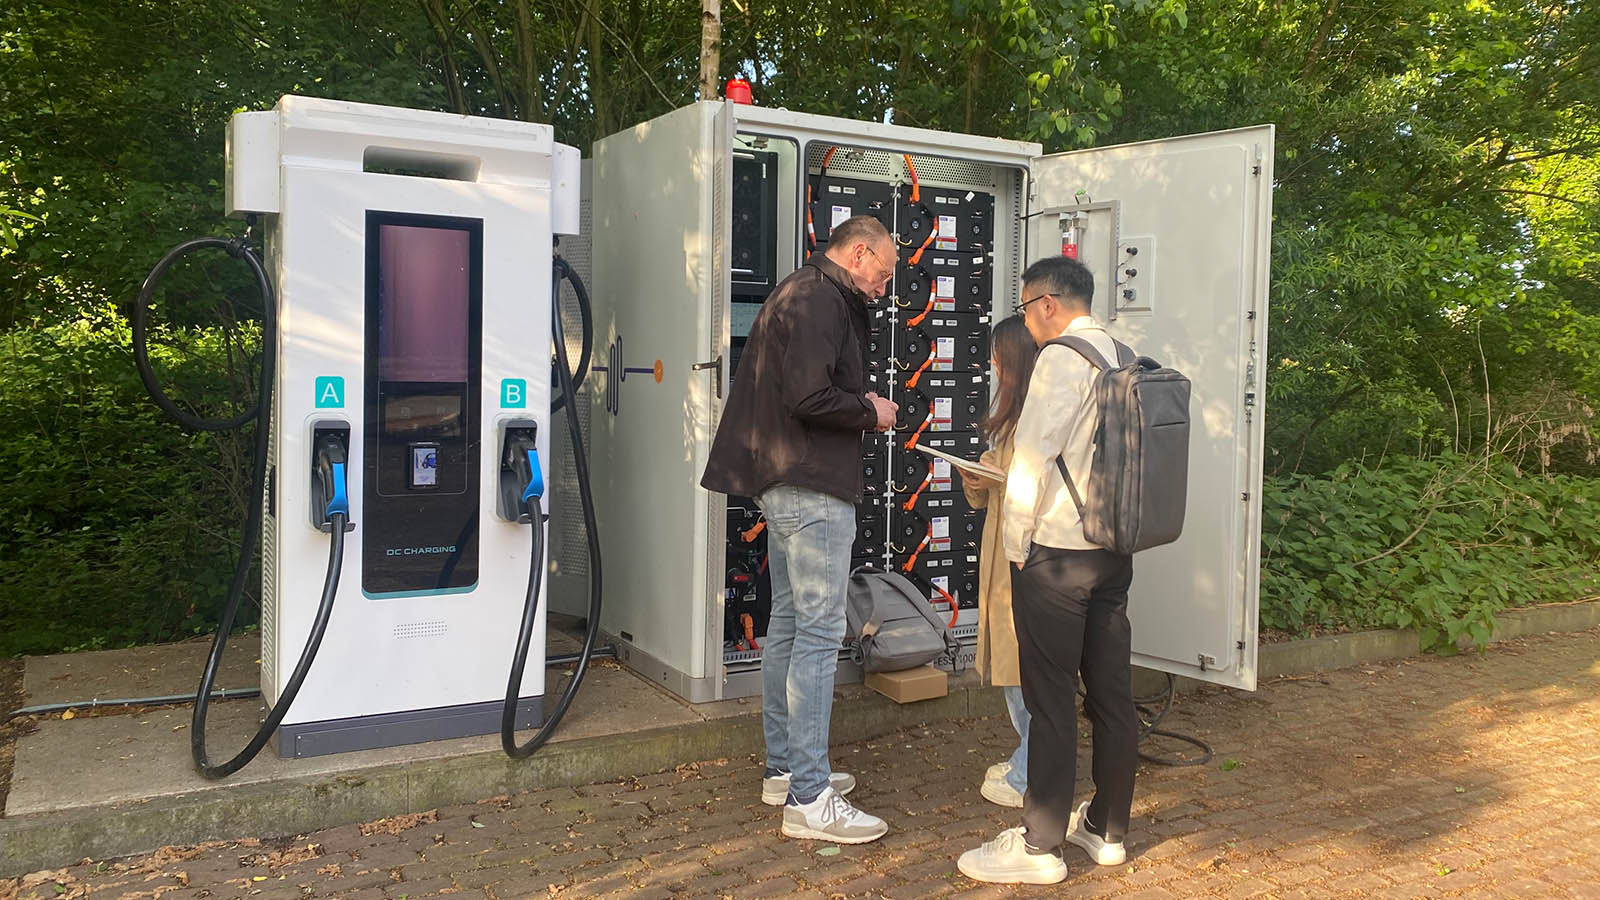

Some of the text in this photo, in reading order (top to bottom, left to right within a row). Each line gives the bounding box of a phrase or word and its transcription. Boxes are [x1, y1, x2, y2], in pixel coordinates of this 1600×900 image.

[320, 382, 339, 403] A
[506, 384, 521, 403] B
[386, 545, 457, 556] DC CHARGING
